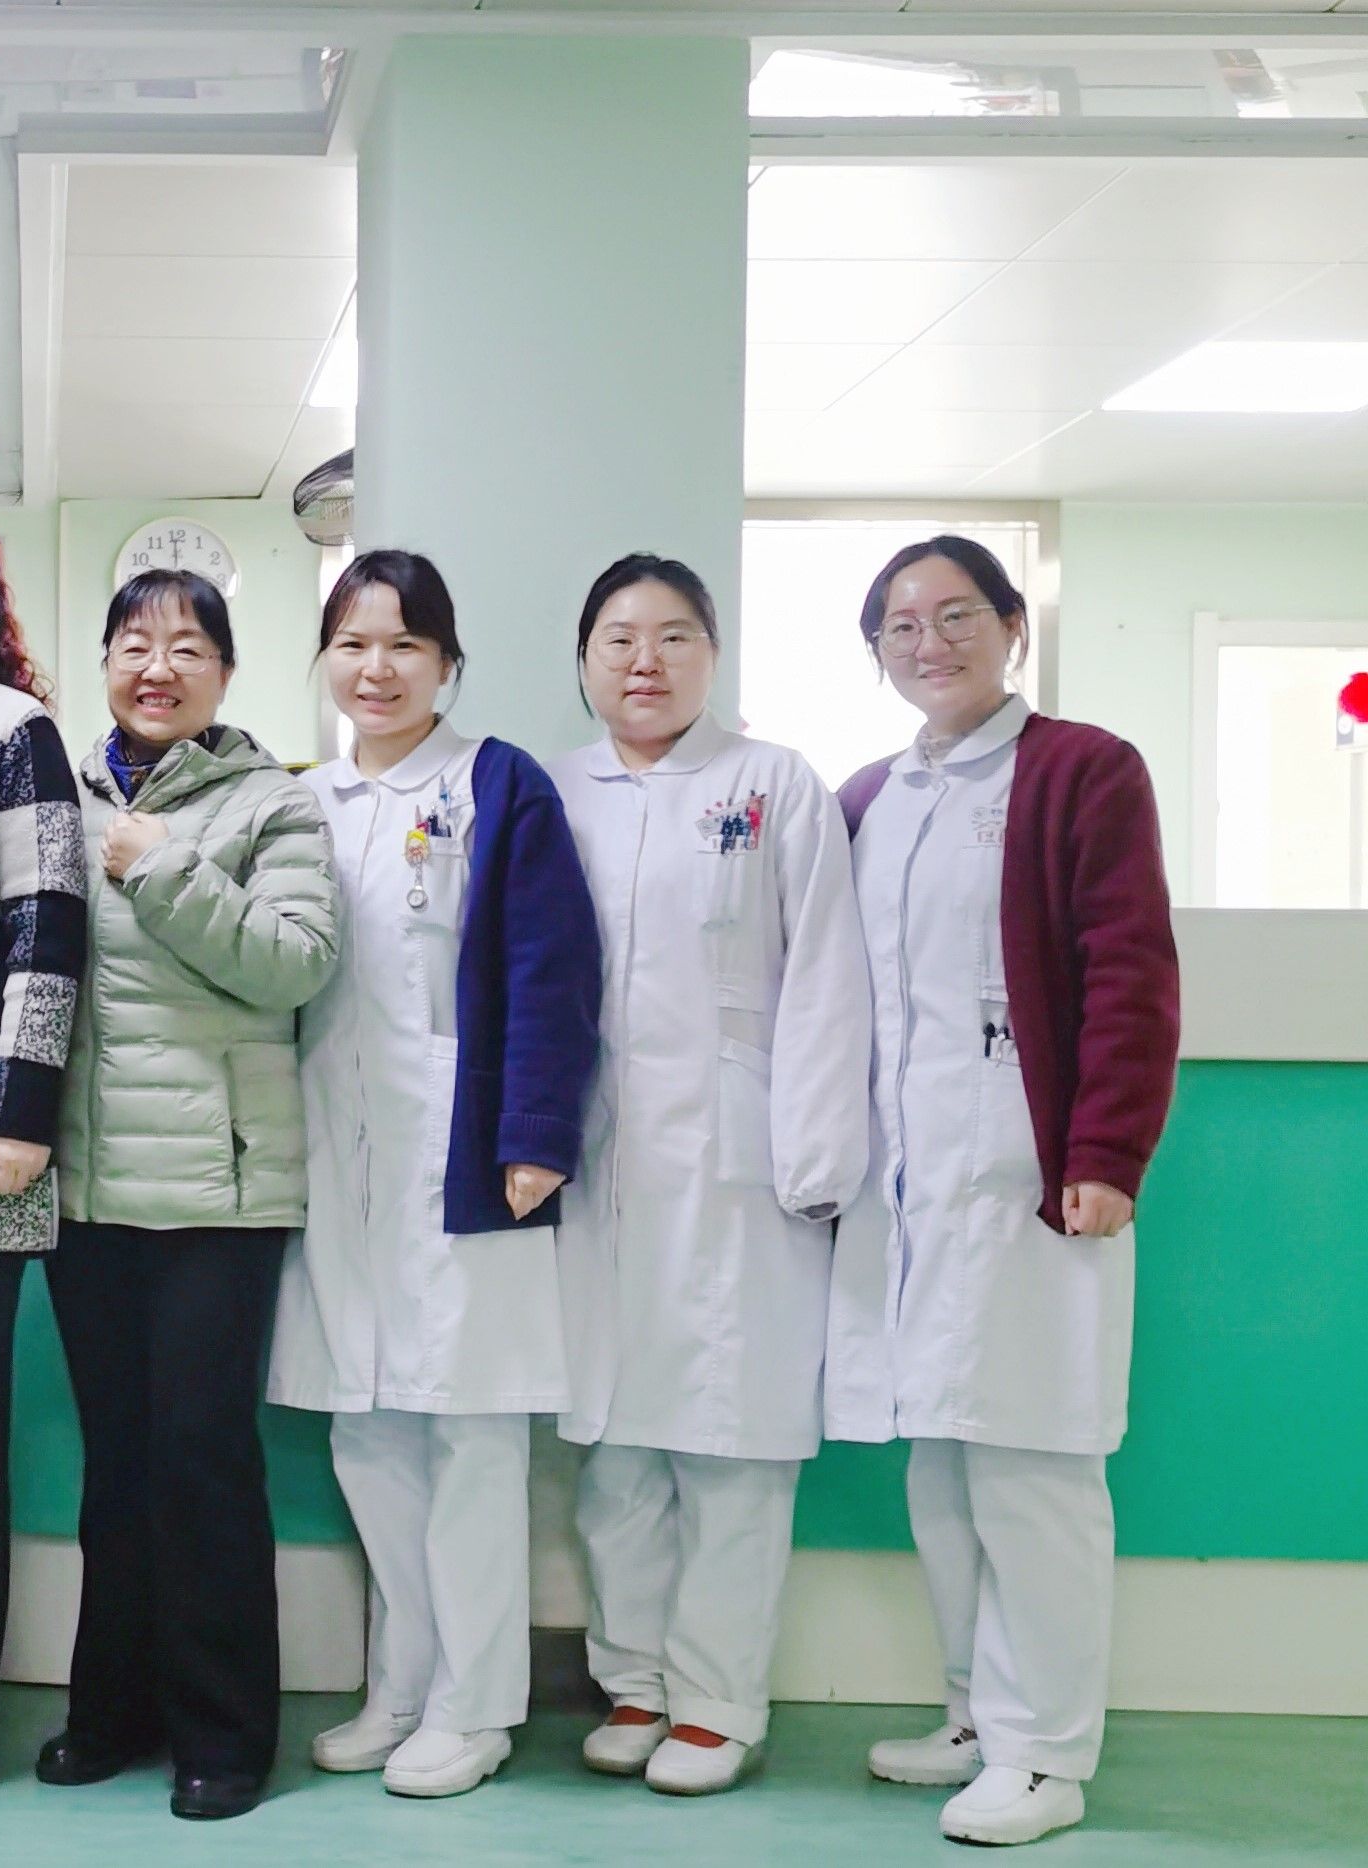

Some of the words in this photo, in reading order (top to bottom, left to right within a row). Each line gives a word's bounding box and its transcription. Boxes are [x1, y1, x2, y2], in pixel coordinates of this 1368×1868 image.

[147, 536, 164, 550] 11
[168, 529, 186, 543] 12
[196, 536, 203, 549] 1
[132, 552, 149, 566] 10
[210, 551, 221, 566] 2
